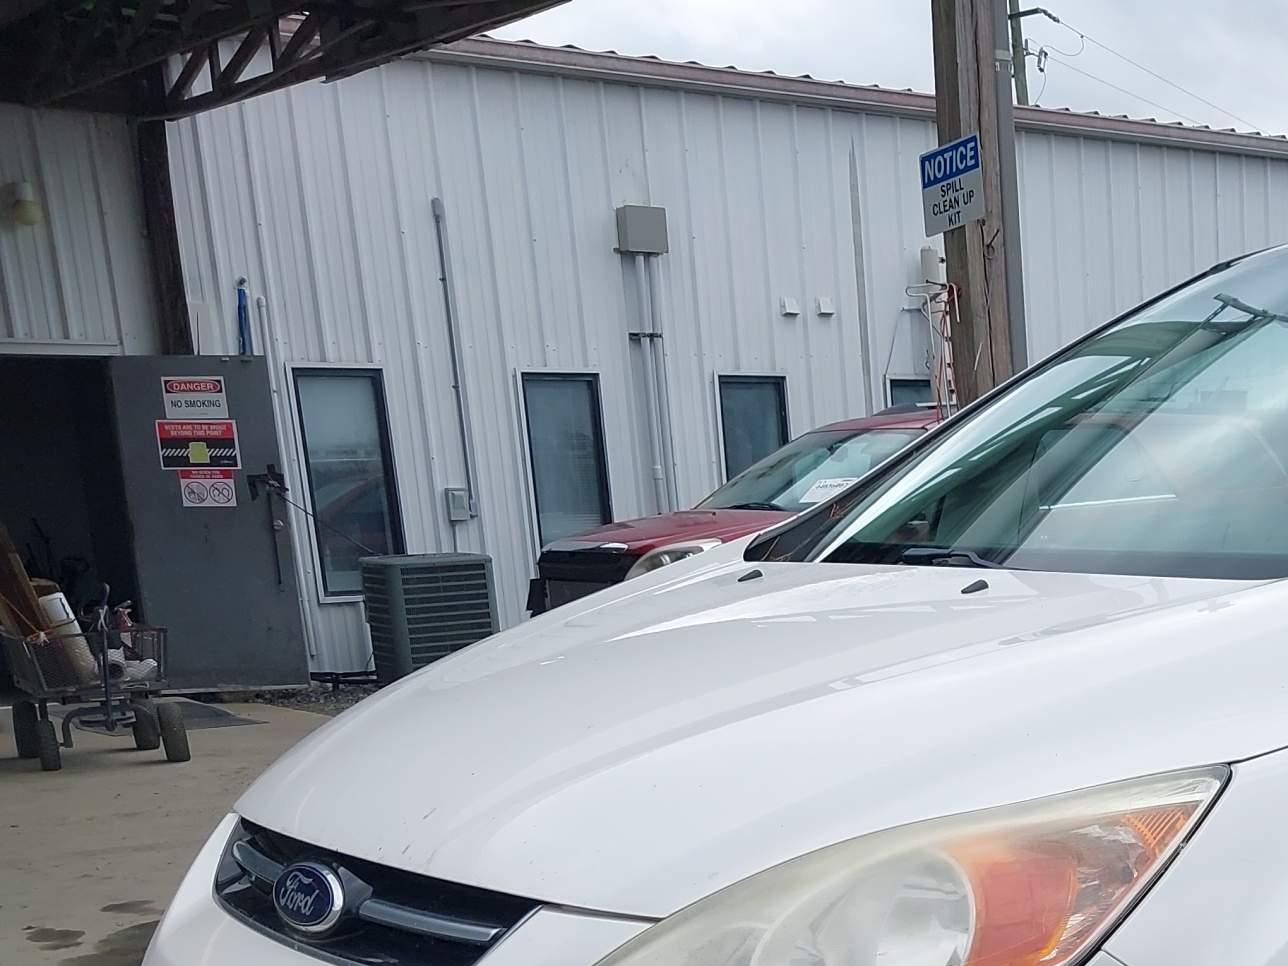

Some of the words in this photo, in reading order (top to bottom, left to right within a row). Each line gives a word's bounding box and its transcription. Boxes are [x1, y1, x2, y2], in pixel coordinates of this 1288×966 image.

[925, 142, 975, 183] NOTICE
[940, 178, 964, 197] SPILL
[933, 198, 960, 216] CLEAN
[963, 190, 975, 206] UP
[947, 211, 961, 228] KIT
[173, 383, 215, 391] DANGER
[171, 400, 182, 408] NO
[185, 400, 221, 408] SMOKING
[279, 871, 320, 916] Ford
